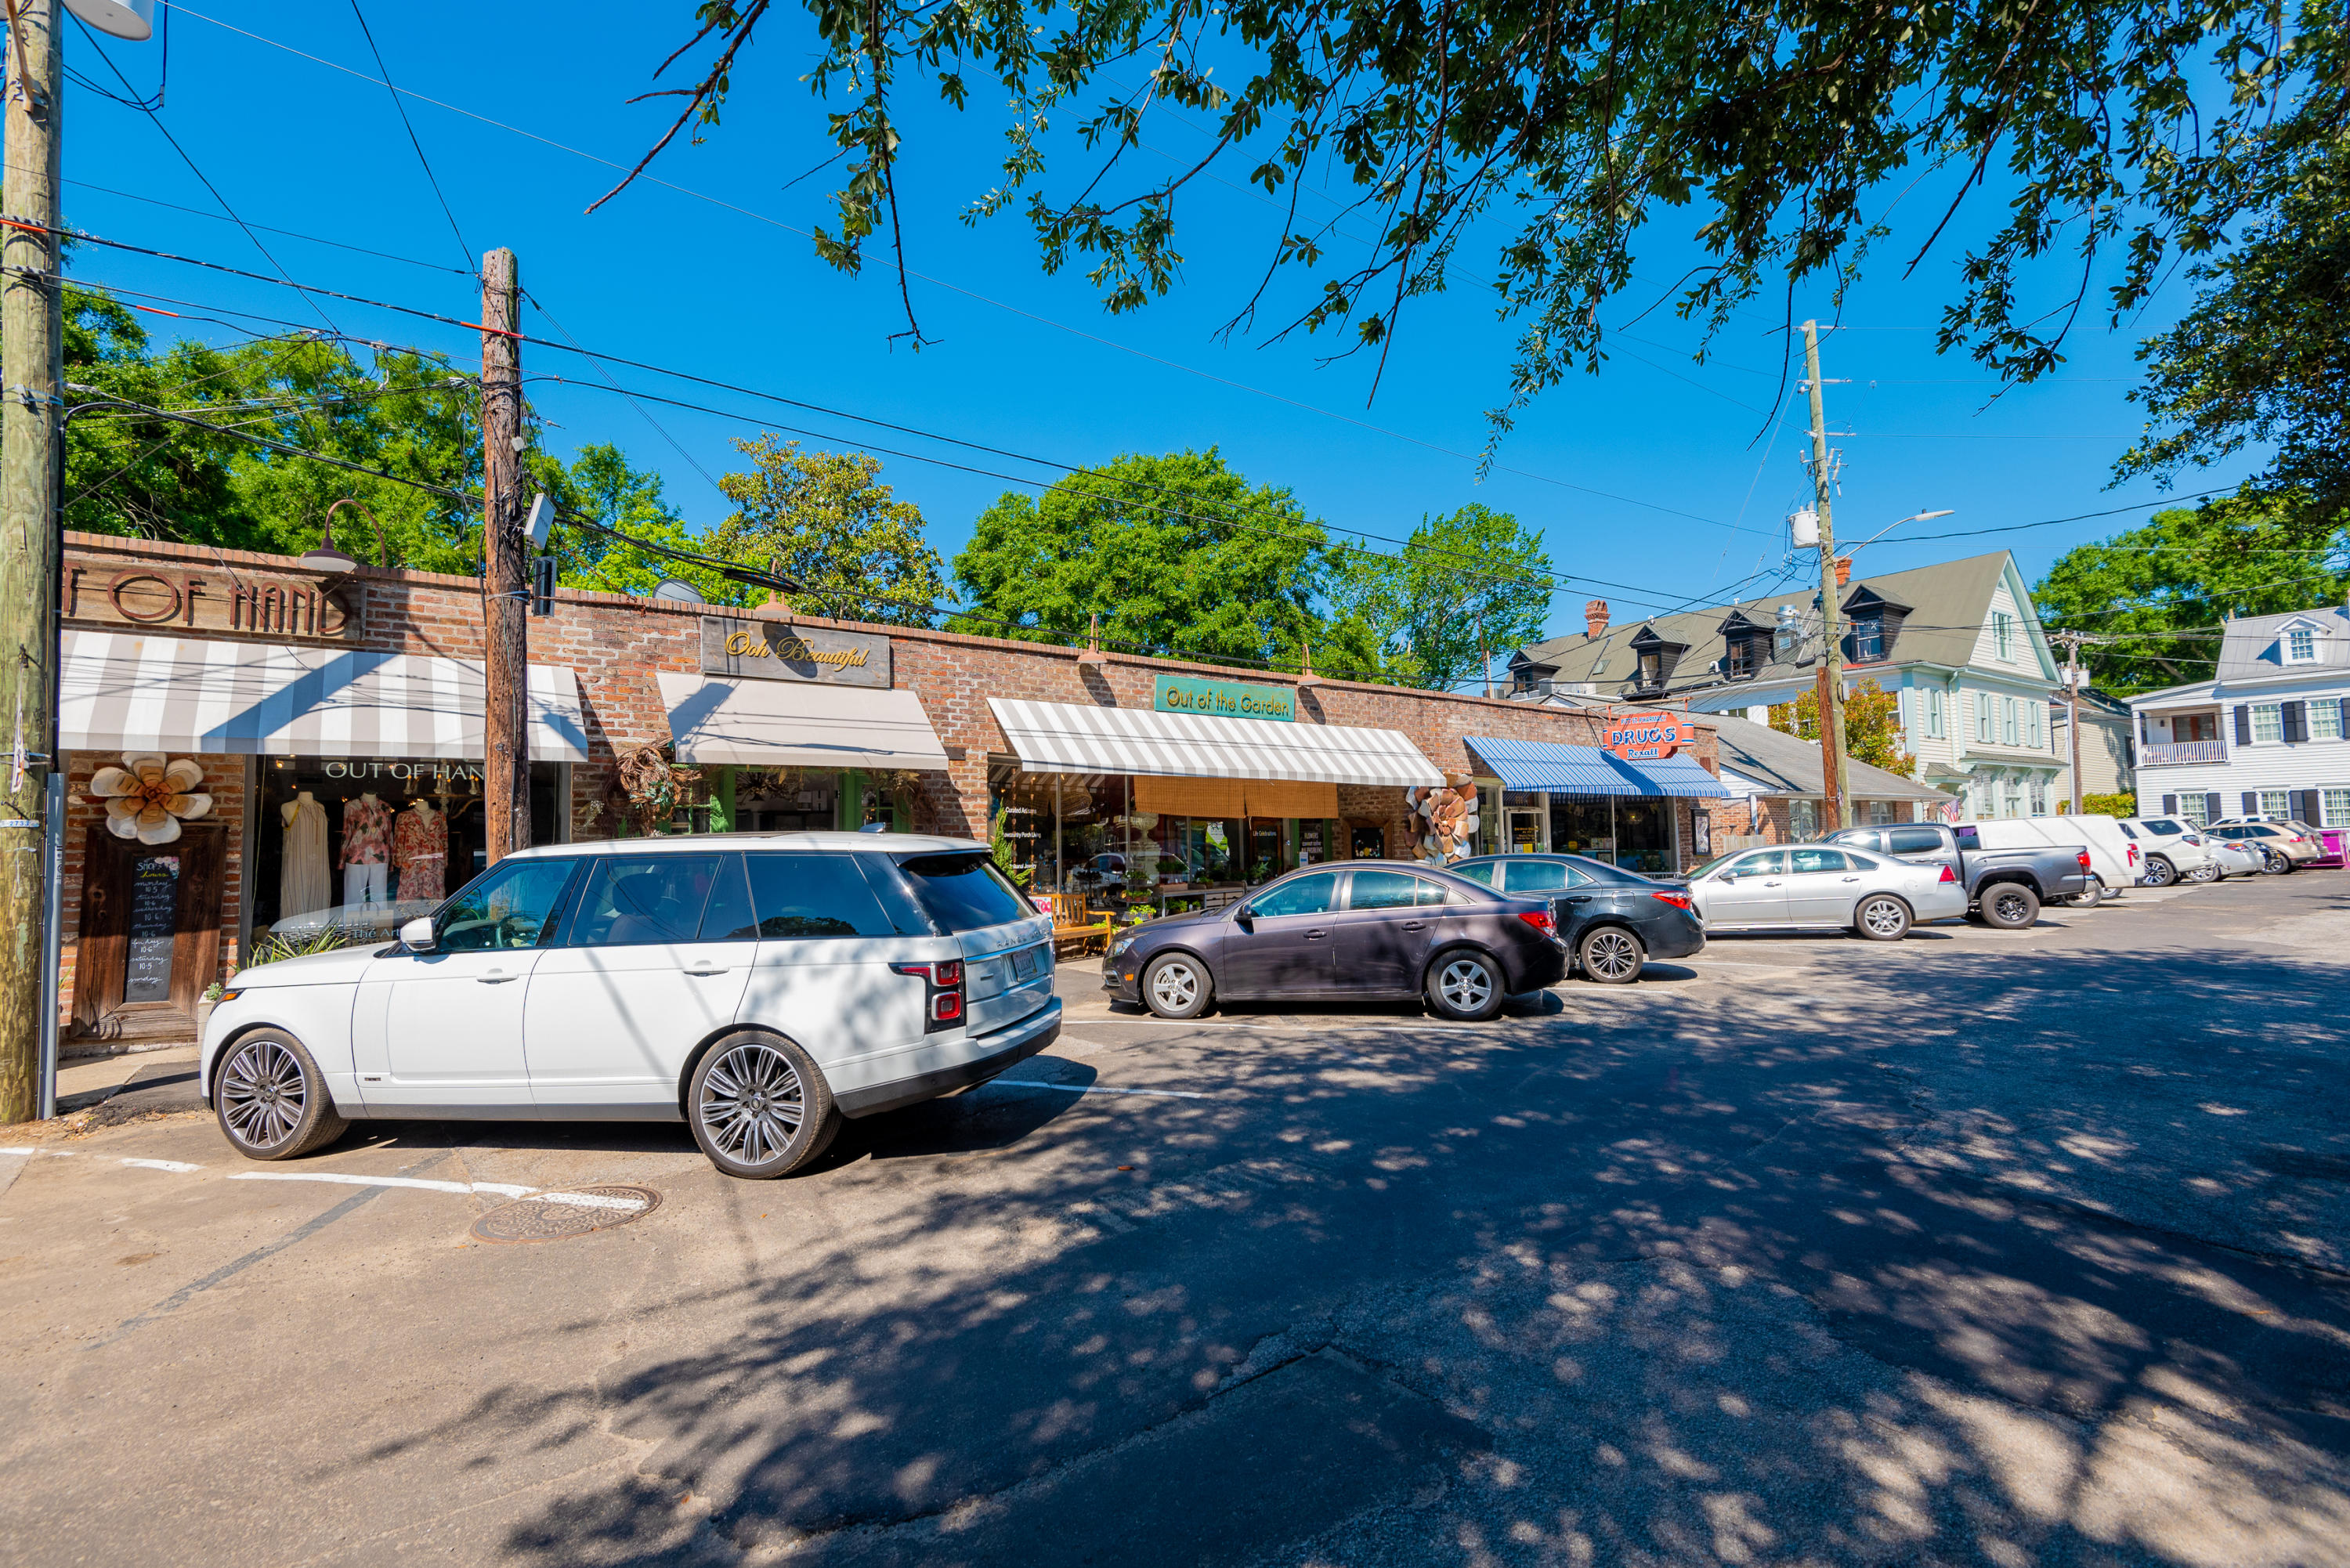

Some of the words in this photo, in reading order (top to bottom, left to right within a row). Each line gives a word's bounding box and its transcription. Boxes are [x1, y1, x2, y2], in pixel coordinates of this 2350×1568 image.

[107, 569, 202, 622] OF
[228, 580, 350, 633] HAND
[725, 631, 770, 658] Ooh
[776, 637, 870, 672] Beautiful
[1166, 685, 1193, 706] Out
[1197, 688, 1212, 706] of
[1216, 689, 1235, 709] the
[1241, 694, 1289, 714] Garden
[1611, 726, 1676, 746] DRUGS
[1627, 747, 1658, 758] Rexall
[325, 762, 383, 779] OUT
[391, 763, 425, 779] OF
[433, 764, 485, 780] HAN
